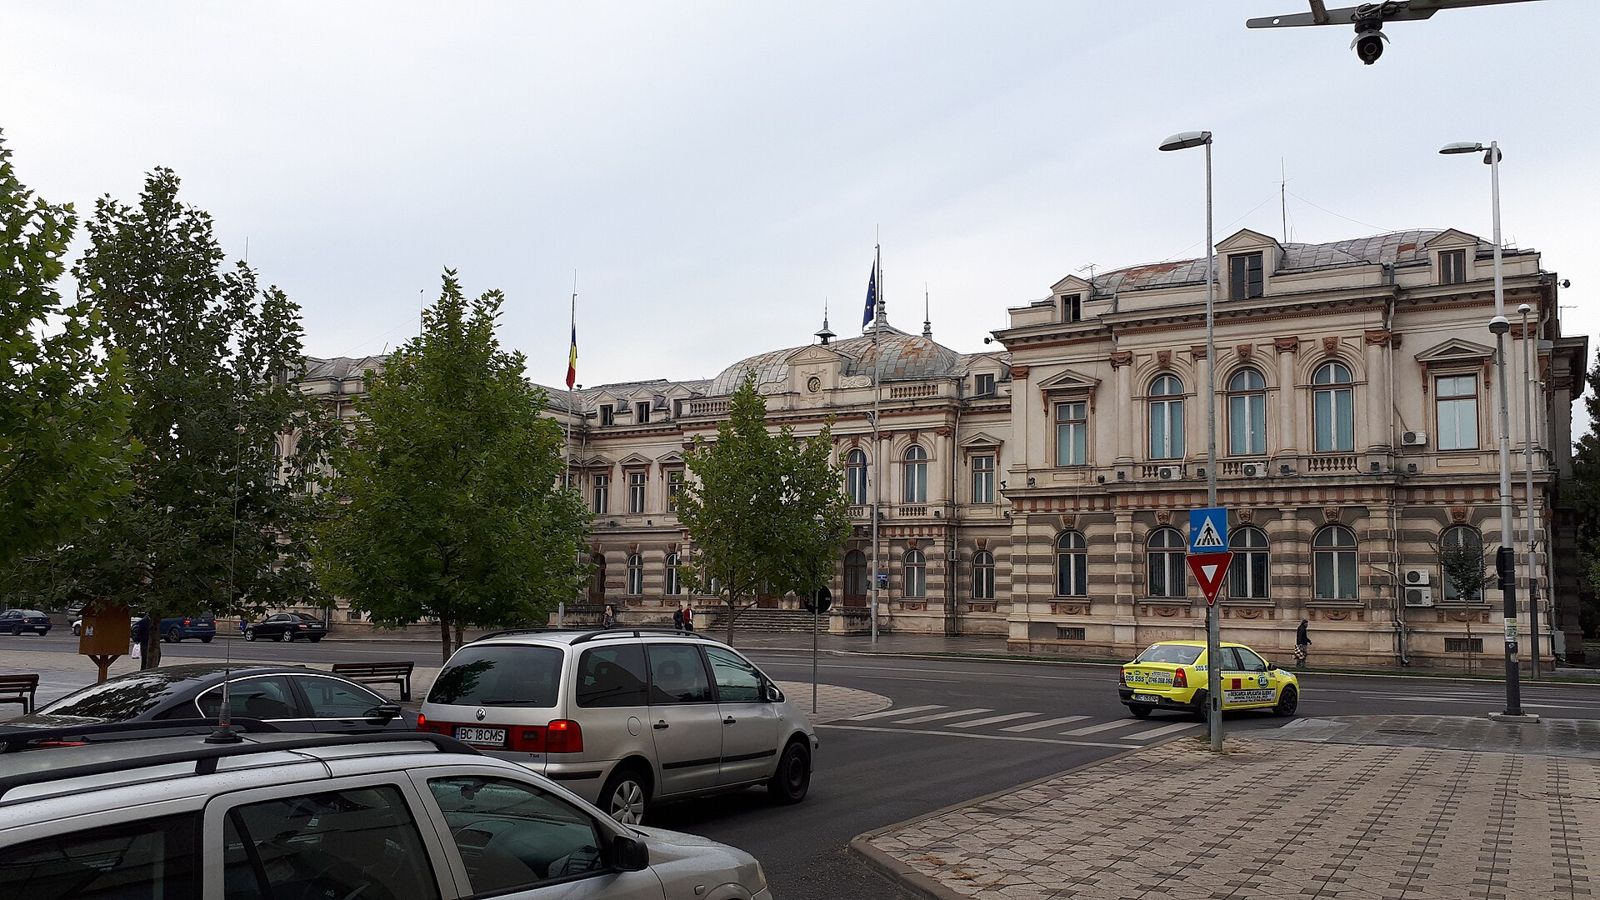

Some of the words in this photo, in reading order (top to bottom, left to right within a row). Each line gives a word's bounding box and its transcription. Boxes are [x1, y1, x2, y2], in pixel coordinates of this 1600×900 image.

[460, 728, 473, 740] BC
[475, 729, 482, 740] 18
[483, 729, 504, 741] CMS
